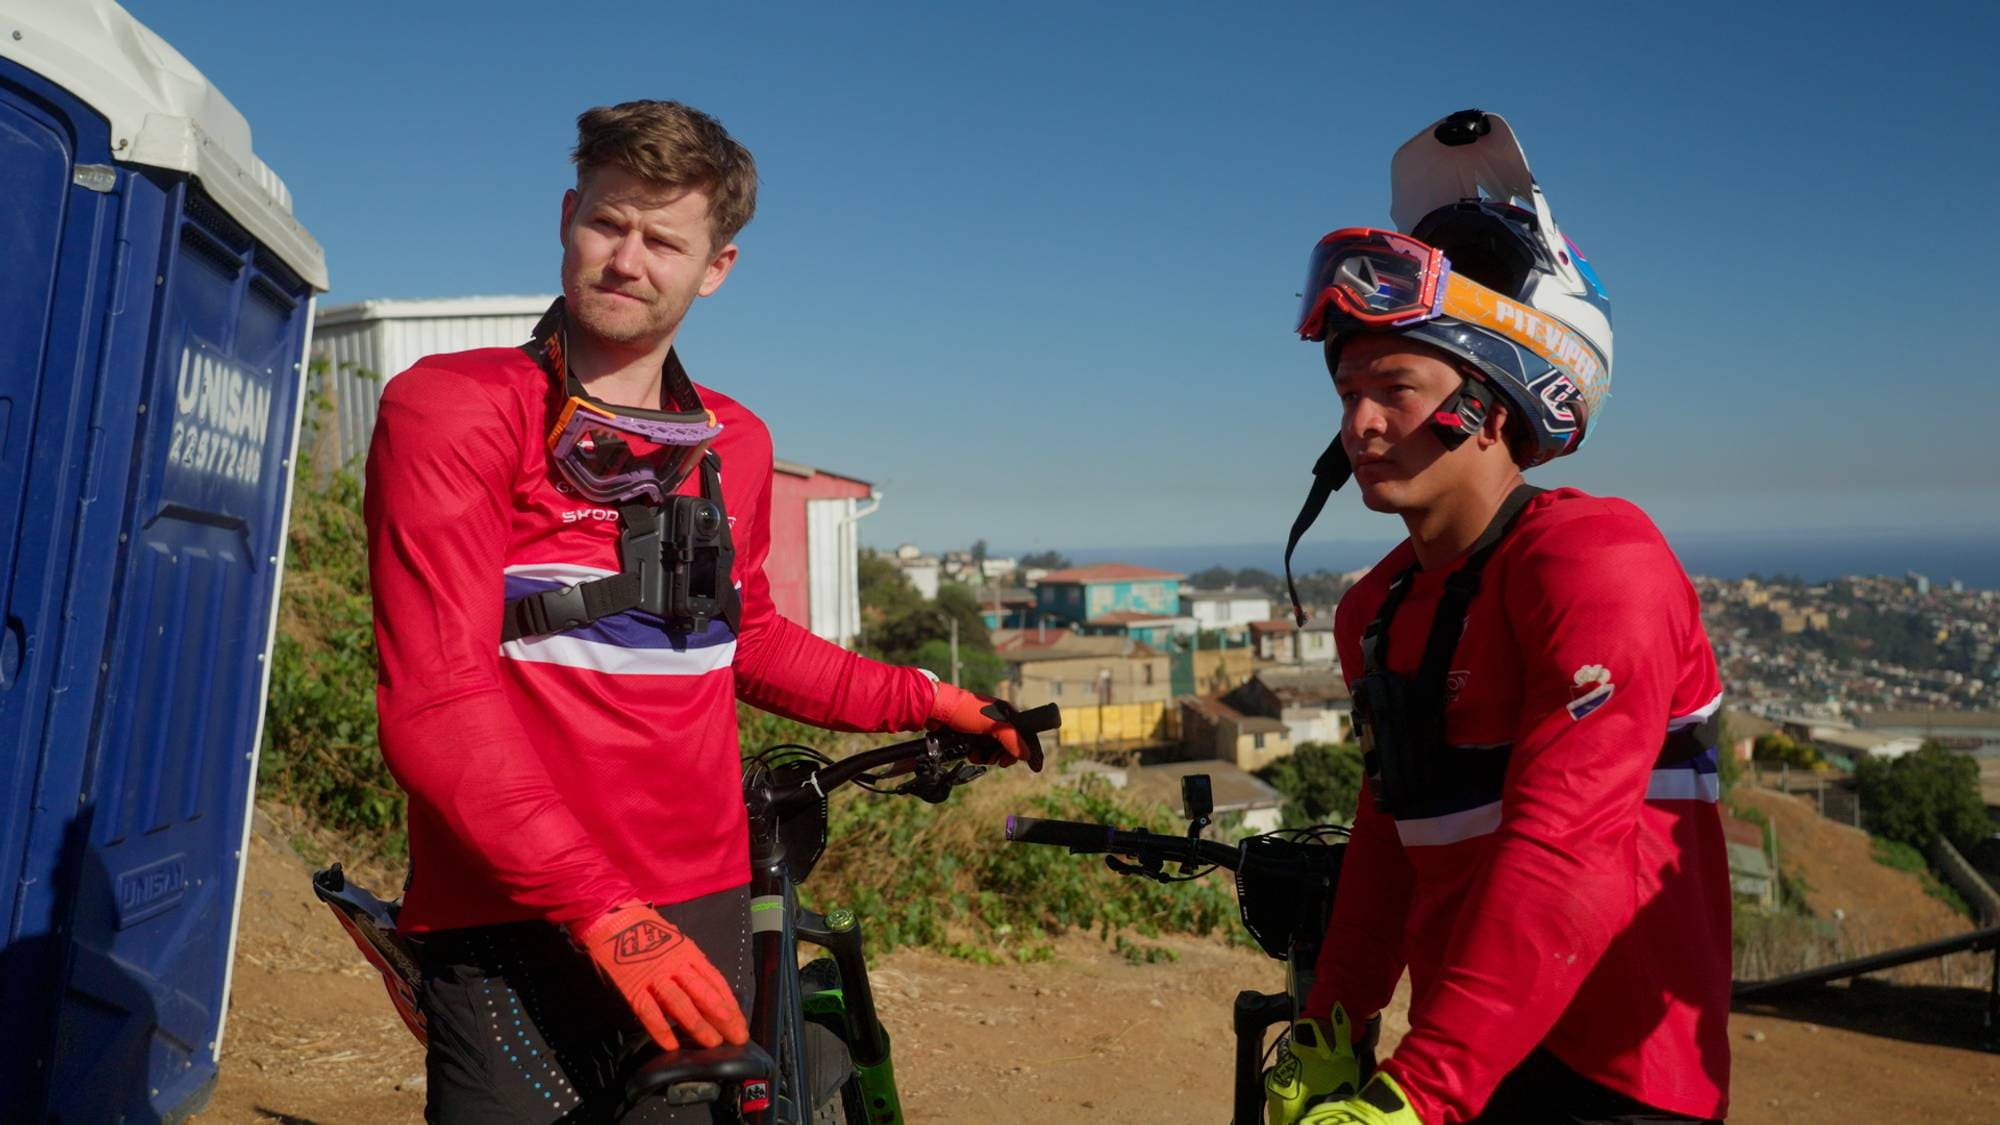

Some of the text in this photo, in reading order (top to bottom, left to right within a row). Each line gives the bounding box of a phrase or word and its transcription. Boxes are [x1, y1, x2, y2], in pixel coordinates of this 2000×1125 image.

[1496, 301, 1541, 338] PIT
[177, 346, 271, 447] UNISAN
[562, 508, 619, 523] SKOD
